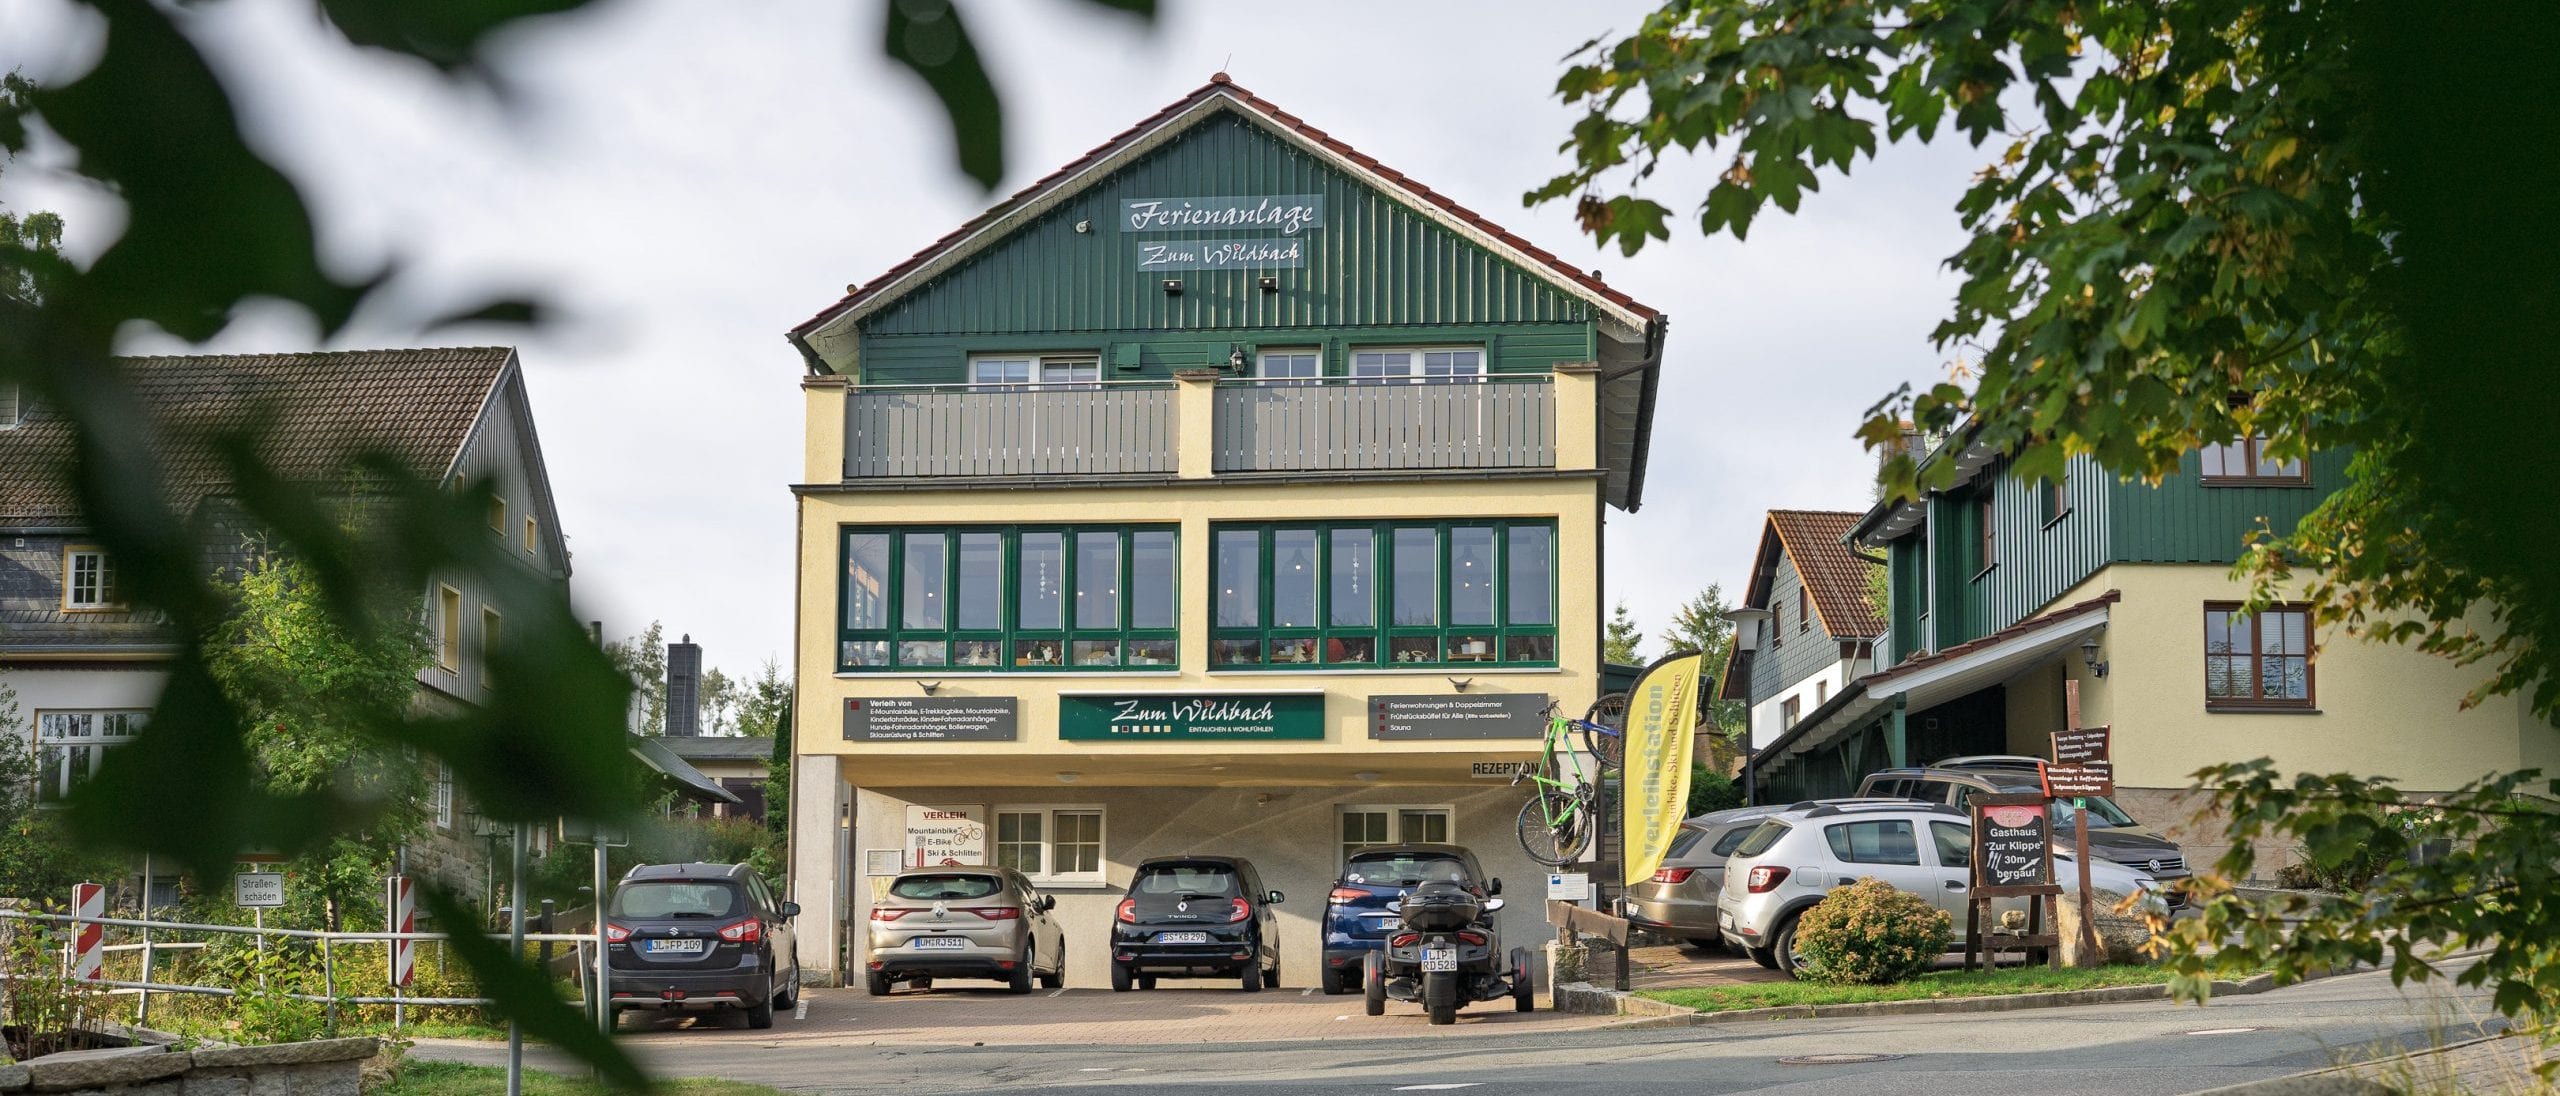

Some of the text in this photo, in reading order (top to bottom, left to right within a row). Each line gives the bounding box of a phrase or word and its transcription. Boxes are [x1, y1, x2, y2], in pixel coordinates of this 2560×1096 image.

[1130, 198, 1314, 234] Ferienanlage
[1141, 243, 1299, 266] Zum Wildbach
[1111, 699, 1274, 722] Zum Wildbach
[1390, 702, 1448, 710] Ferienwohnungen
[1232, 725, 1274, 733] WOHLFÜHLEN
[924, 811, 967, 819] VERLEIH
[1990, 828, 2037, 837] Gasthaus
[1985, 841, 2043, 851] "Zur Klippe"
[2005, 855, 2026, 864] 30m
[1997, 868, 2036, 879] bergauf
[242, 879, 277, 889] Straßen-
[1164, 933, 1173, 941] BS
[1191, 933, 1205, 941] 296
[653, 940, 700, 950] JL FP 109
[948, 938, 962, 947] 511
[1429, 951, 1447, 960] LIP
[1437, 960, 1456, 970] 528
